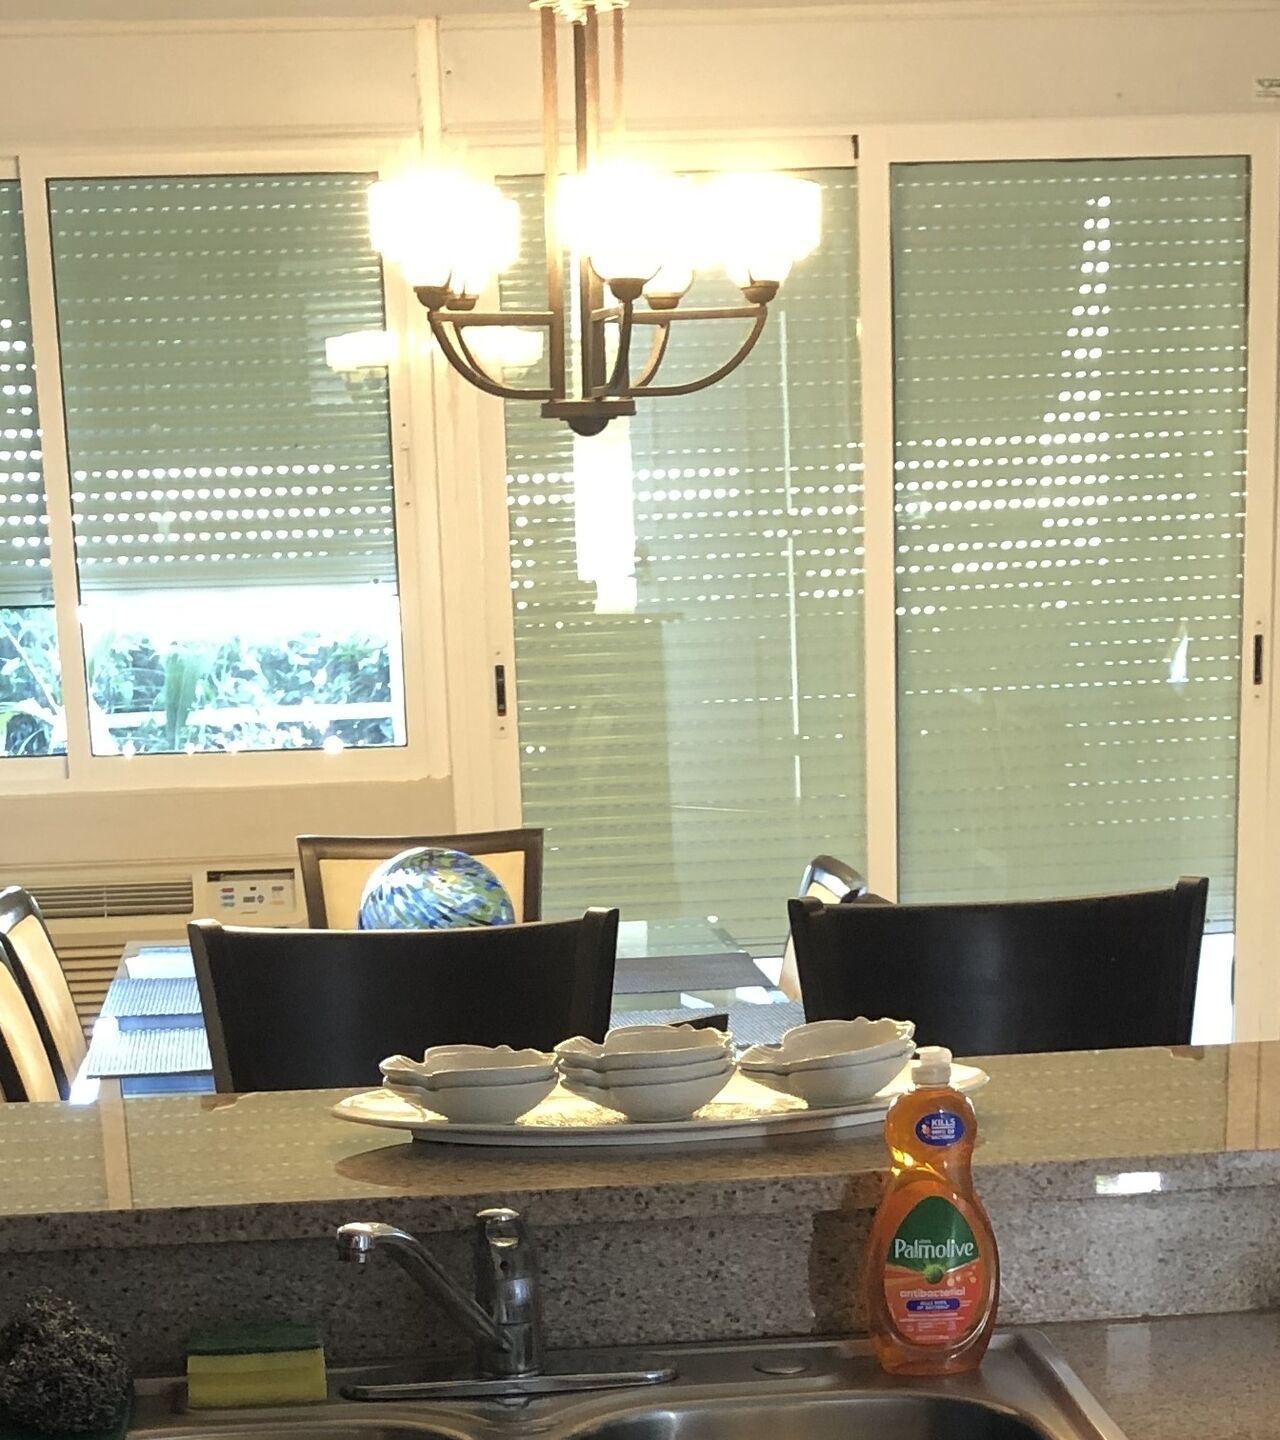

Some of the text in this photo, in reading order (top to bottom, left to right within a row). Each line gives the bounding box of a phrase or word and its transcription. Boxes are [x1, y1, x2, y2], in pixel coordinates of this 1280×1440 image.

[931, 1118, 956, 1127] KILLS
[894, 1238, 974, 1259] Palmolive
[900, 1286, 966, 1298] antibacterial
